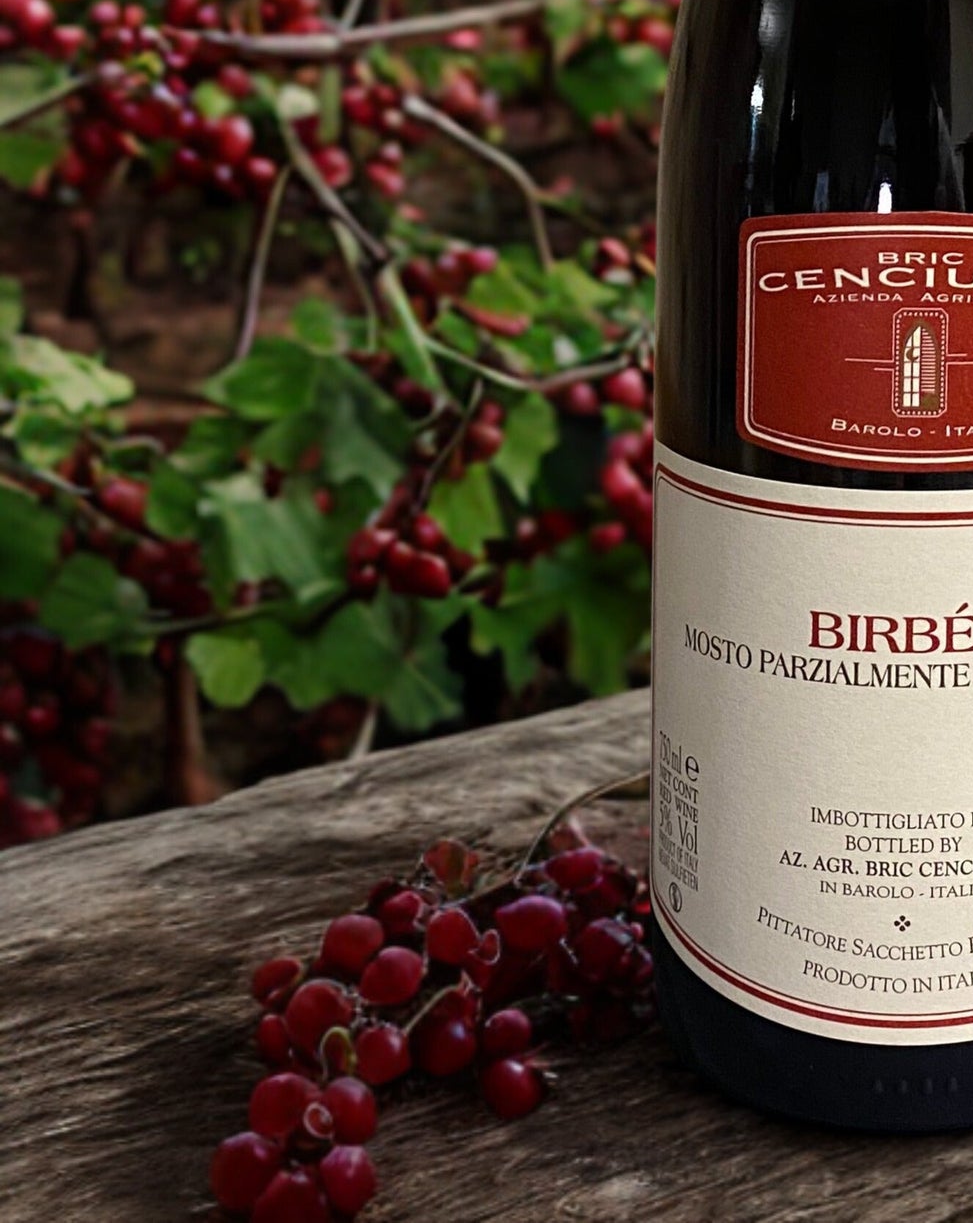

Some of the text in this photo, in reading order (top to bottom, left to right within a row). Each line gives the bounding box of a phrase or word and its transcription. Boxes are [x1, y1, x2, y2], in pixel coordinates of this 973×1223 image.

[878, 251, 965, 265] BRIC
[813, 293, 903, 303] AZIENDA
[685, 624, 752, 670] MOSTO
[759, 648, 971, 689] PARZIALMENTE
[673, 777, 698, 804] CONT
[675, 796, 698, 824] WINE
[810, 807, 965, 830] IMBOTTIGLIATO
[678, 815, 697, 855] Vol
[845, 835, 963, 853] BOTTLED BY
[779, 850, 807, 869] AZ.
[812, 856, 859, 875] AGR.
[866, 861, 914, 877] BRIC
[819, 880, 837, 894] IN
[842, 883, 914, 899] BAROLO
[803, 959, 907, 994] PRODOTTO
[912, 978, 932, 993] IN
